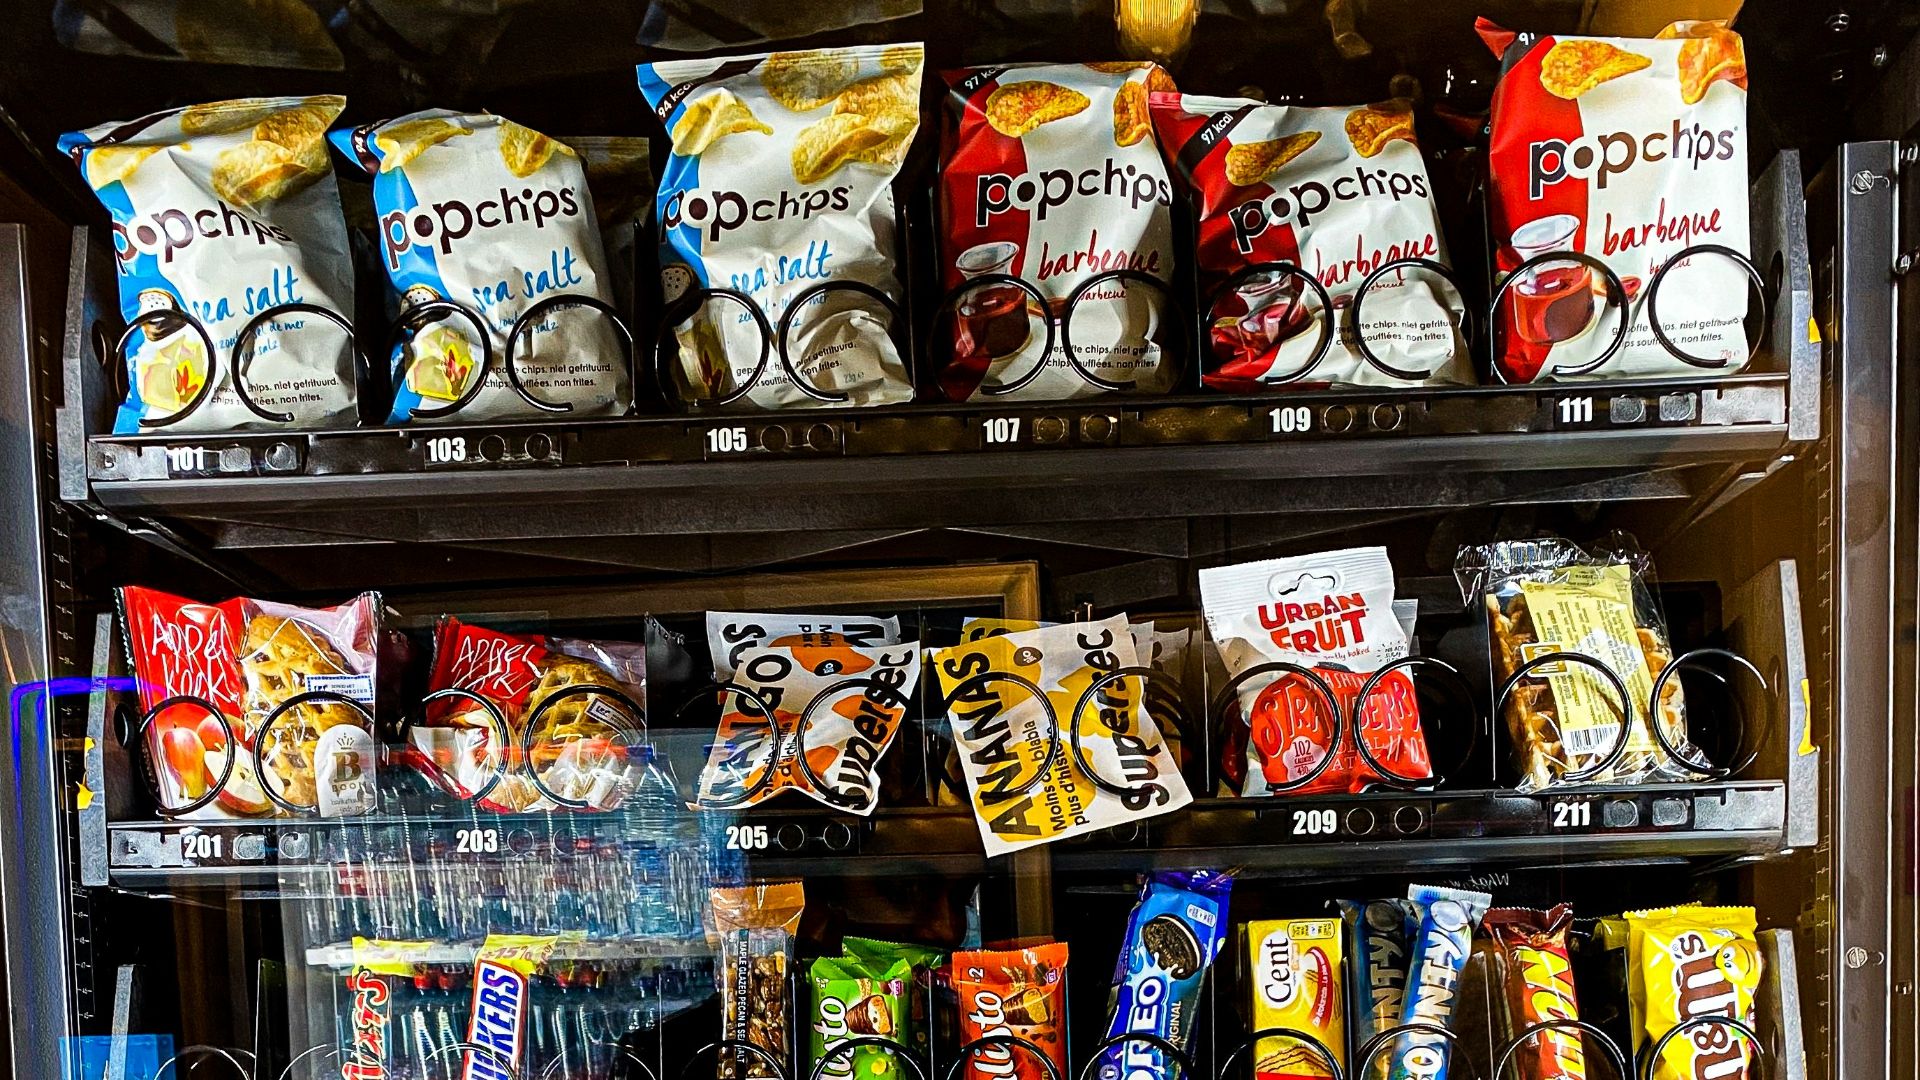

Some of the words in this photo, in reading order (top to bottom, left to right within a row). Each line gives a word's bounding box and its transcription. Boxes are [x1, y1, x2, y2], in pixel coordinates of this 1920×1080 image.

[965, 76, 979, 90] 97
[657, 100, 672, 118] 94
[1200, 128, 1215, 145] 97
[1213, 112, 1234, 133] kcal
[1530, 119, 1734, 199] popchips
[976, 158, 1172, 227] popchips
[661, 186, 850, 243] popchips
[1229, 166, 1428, 253] popchips
[112, 201, 294, 275] popchips
[382, 187, 579, 270] popchips
[1603, 198, 1722, 256] barbeque
[731, 266, 768, 296] sea
[774, 240, 832, 285] salt
[1038, 230, 1160, 289] barbeque
[1315, 234, 1437, 288] barbeque
[472, 281, 515, 312] sea
[522, 247, 581, 297] salt
[193, 296, 235, 323] sea
[241, 266, 303, 315] salt
[1373, 321, 1399, 330] chips.
[1401, 321, 1417, 329] niet
[1406, 333, 1423, 341] non
[1680, 320, 1697, 329] niet
[1085, 345, 1111, 354] chips.
[1114, 346, 1130, 355] niet
[1681, 336, 1698, 344] non
[1700, 333, 1723, 343] frites.
[521, 365, 548, 375] chips.
[549, 364, 566, 374] niet
[800, 366, 818, 376] non
[274, 381, 290, 390] niet
[1269, 406, 1311, 432] 109
[1558, 396, 1593, 423] 111
[706, 427, 747, 452] 105
[982, 417, 1021, 443] 107
[169, 446, 204, 471] 101
[426, 437, 466, 462] 103
[1257, 592, 1366, 630] URBAN
[1077, 628, 1170, 812] supersec
[943, 652, 1042, 836] ANANAS
[1022, 719, 1046, 763] blabla
[1293, 739, 1311, 757] 102
[1045, 786, 1068, 831] Moins
[1068, 794, 1090, 826] plus
[1553, 801, 1590, 827] 211
[1293, 810, 1337, 835] 209
[183, 834, 222, 859] 201
[456, 829, 498, 854] 203
[726, 826, 768, 849] 205
[738, 941, 747, 965] MAPLE
[738, 967, 747, 995] GLAZED
[1264, 938, 1292, 1003] Cent
[737, 996, 746, 1021] PECAN
[1516, 946, 1586, 1079] LION
[1168, 1000, 1182, 1045] RIGINAL
[737, 1045, 745, 1064] ALT
